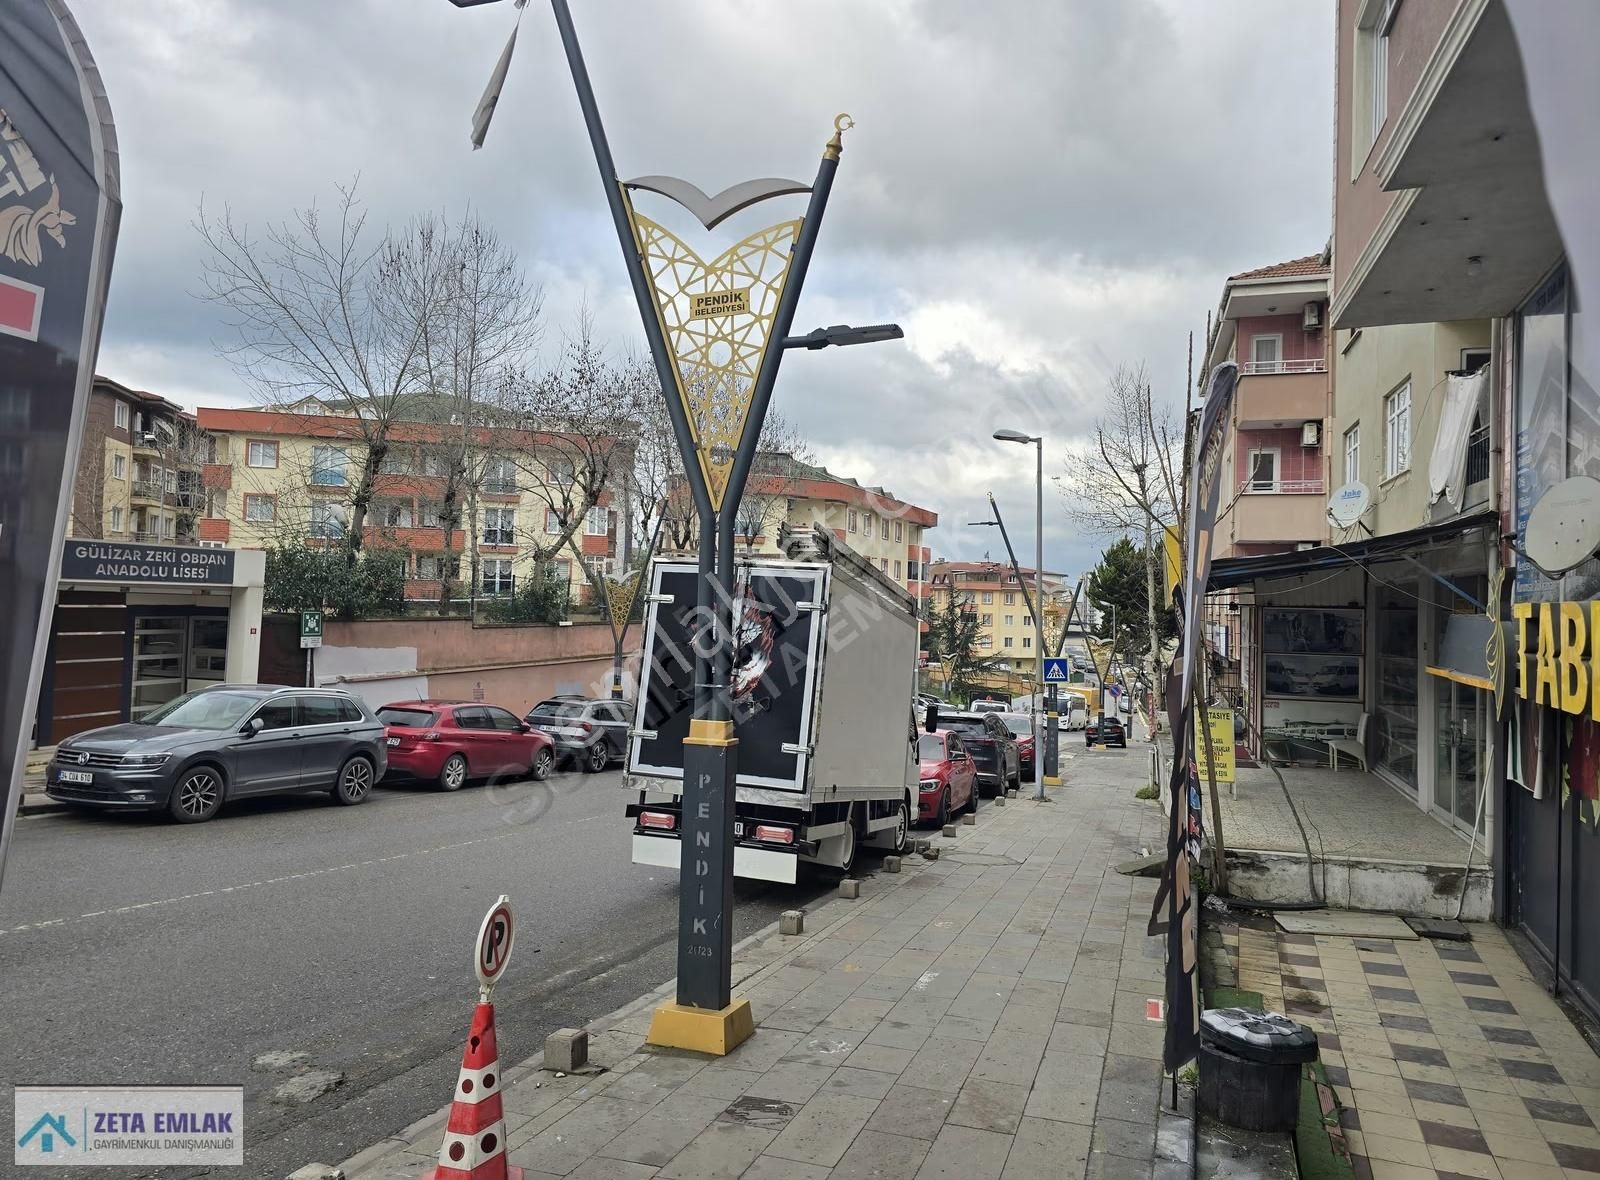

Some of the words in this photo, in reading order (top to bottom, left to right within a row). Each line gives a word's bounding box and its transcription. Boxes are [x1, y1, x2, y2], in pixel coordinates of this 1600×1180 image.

[697, 292, 743, 307] PENDİK
[695, 302, 745, 316] BELEDİYESİ
[75, 544, 141, 561] GÜLİZAR
[145, 549, 176, 563] ZEKİ
[181, 553, 226, 566] OBDAN
[96, 564, 168, 577] ANADOLU
[172, 565, 209, 579] LİSESİ
[1513, 601, 1600, 721] TAB
